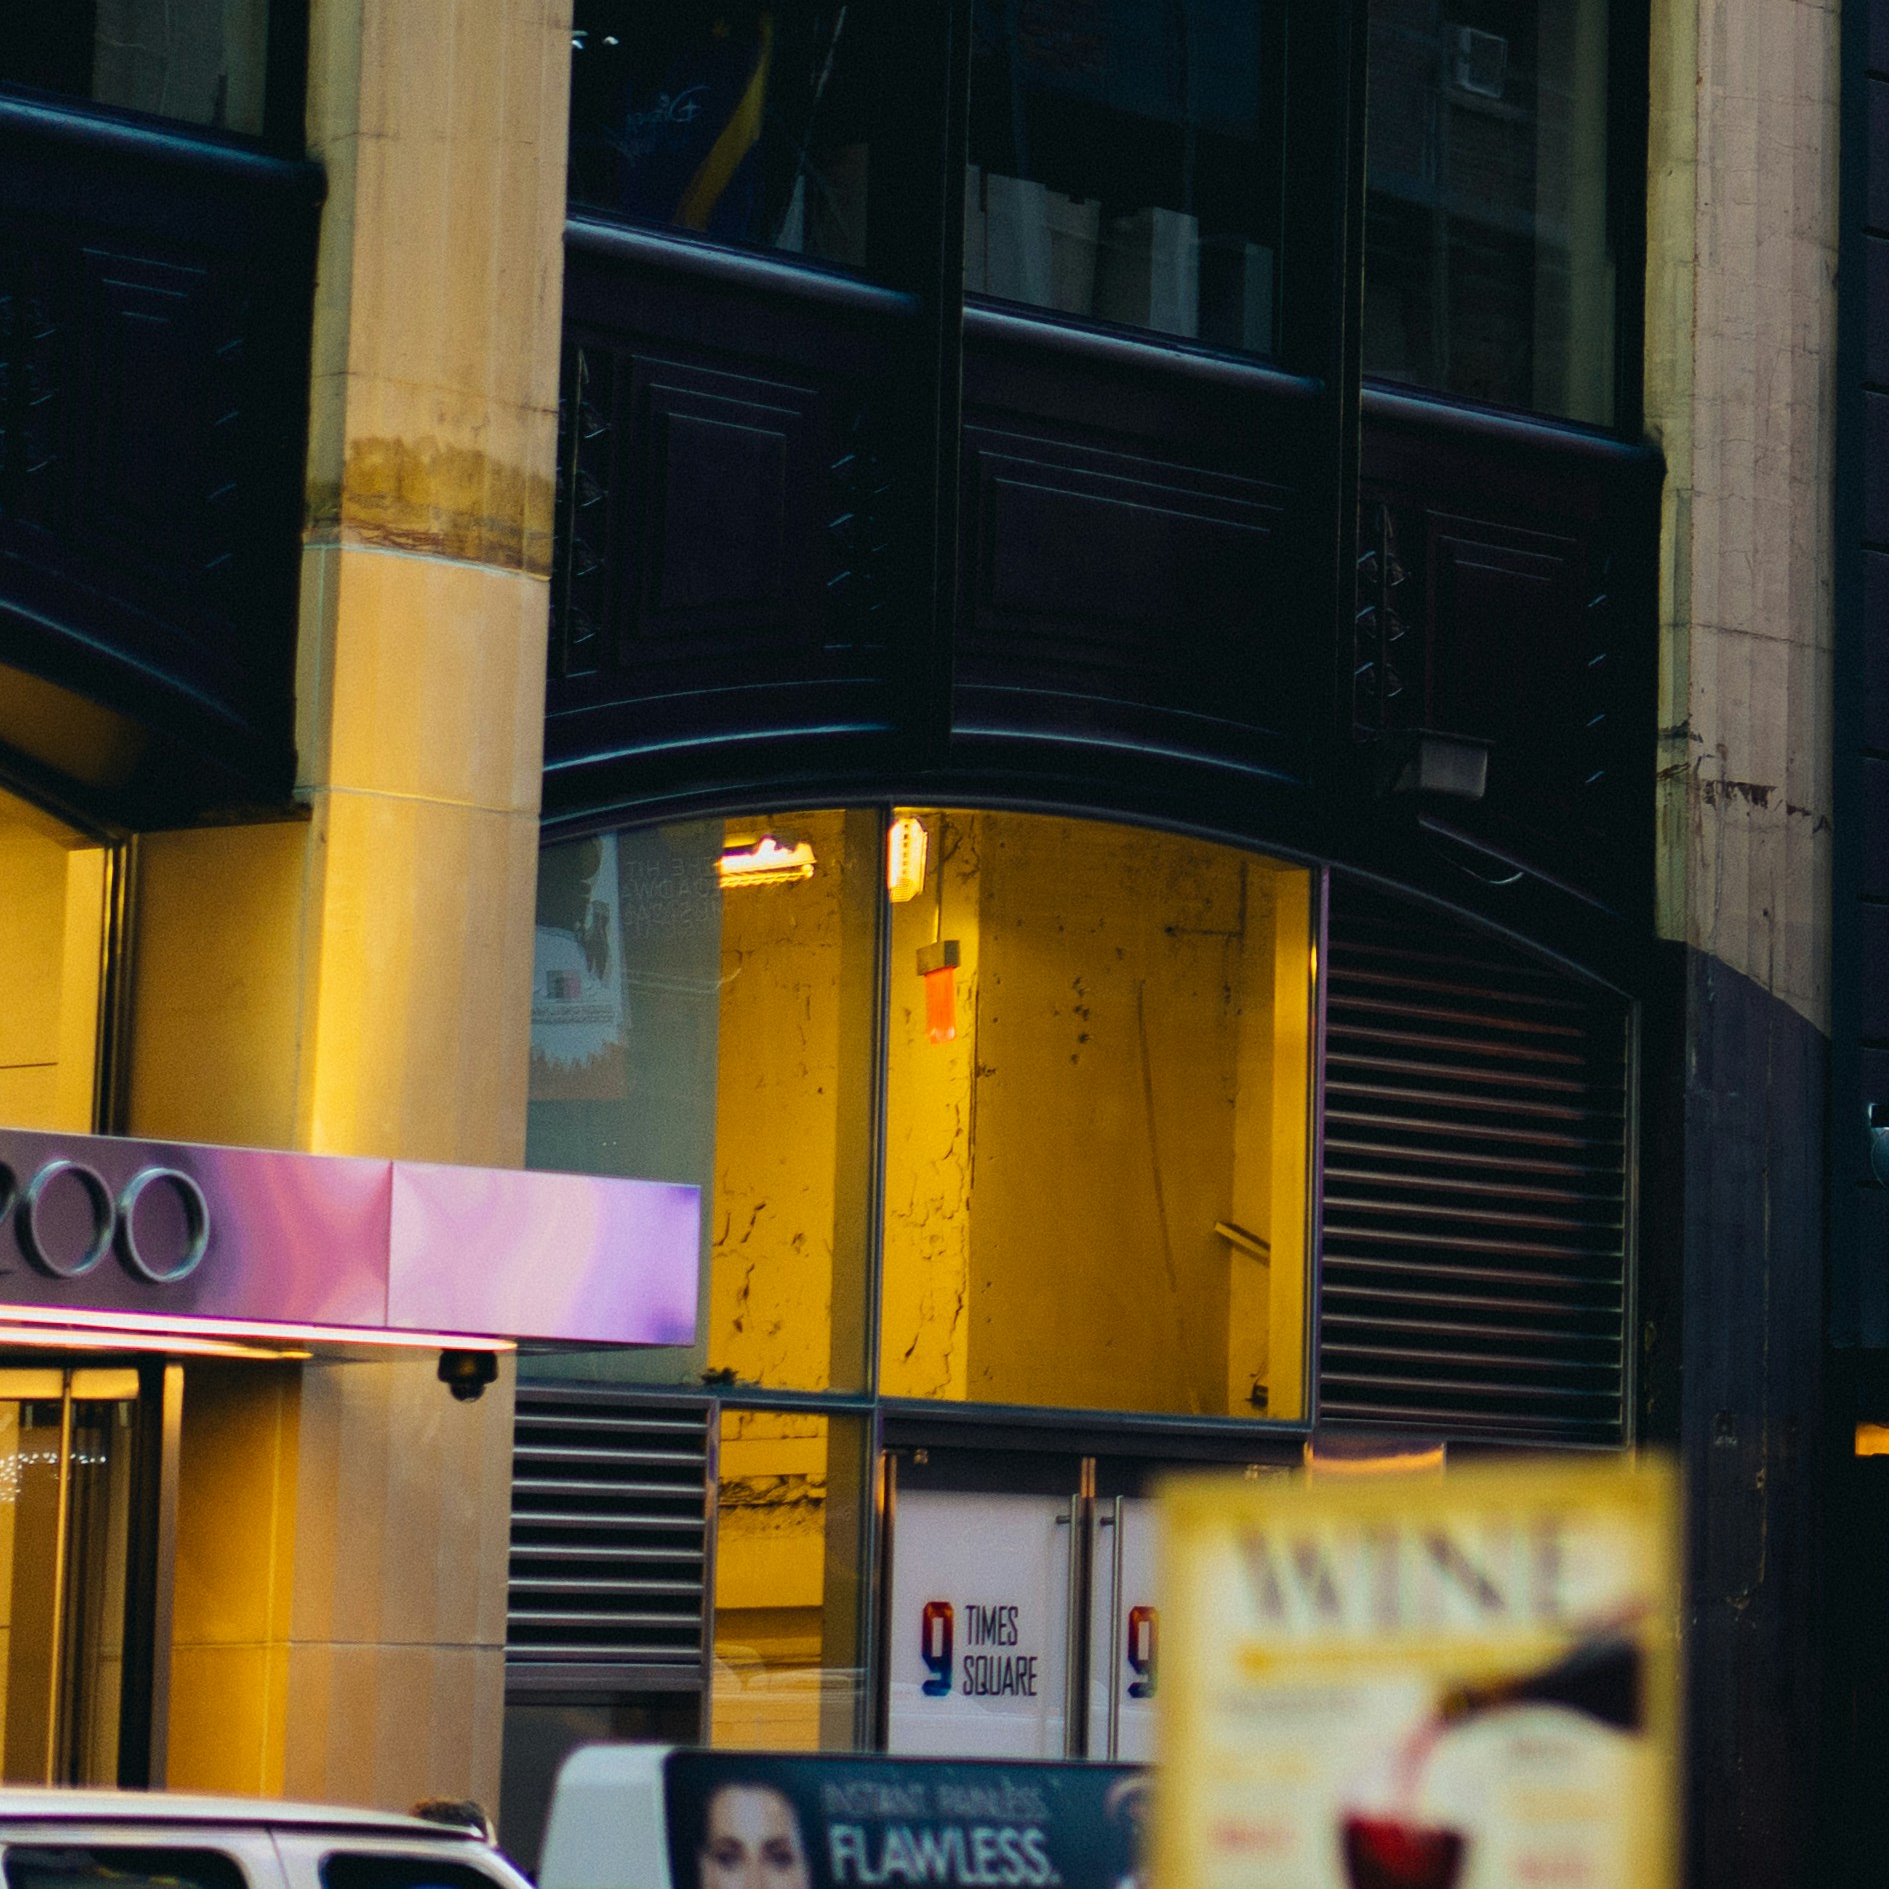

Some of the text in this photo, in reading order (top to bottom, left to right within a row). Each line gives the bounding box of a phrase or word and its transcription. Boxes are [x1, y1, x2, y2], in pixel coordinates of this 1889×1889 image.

[921, 1601, 1019, 1697] 9 TIMES
[962, 1655, 1038, 1697] SQUARE
[1127, 1606, 1158, 1699] 9
